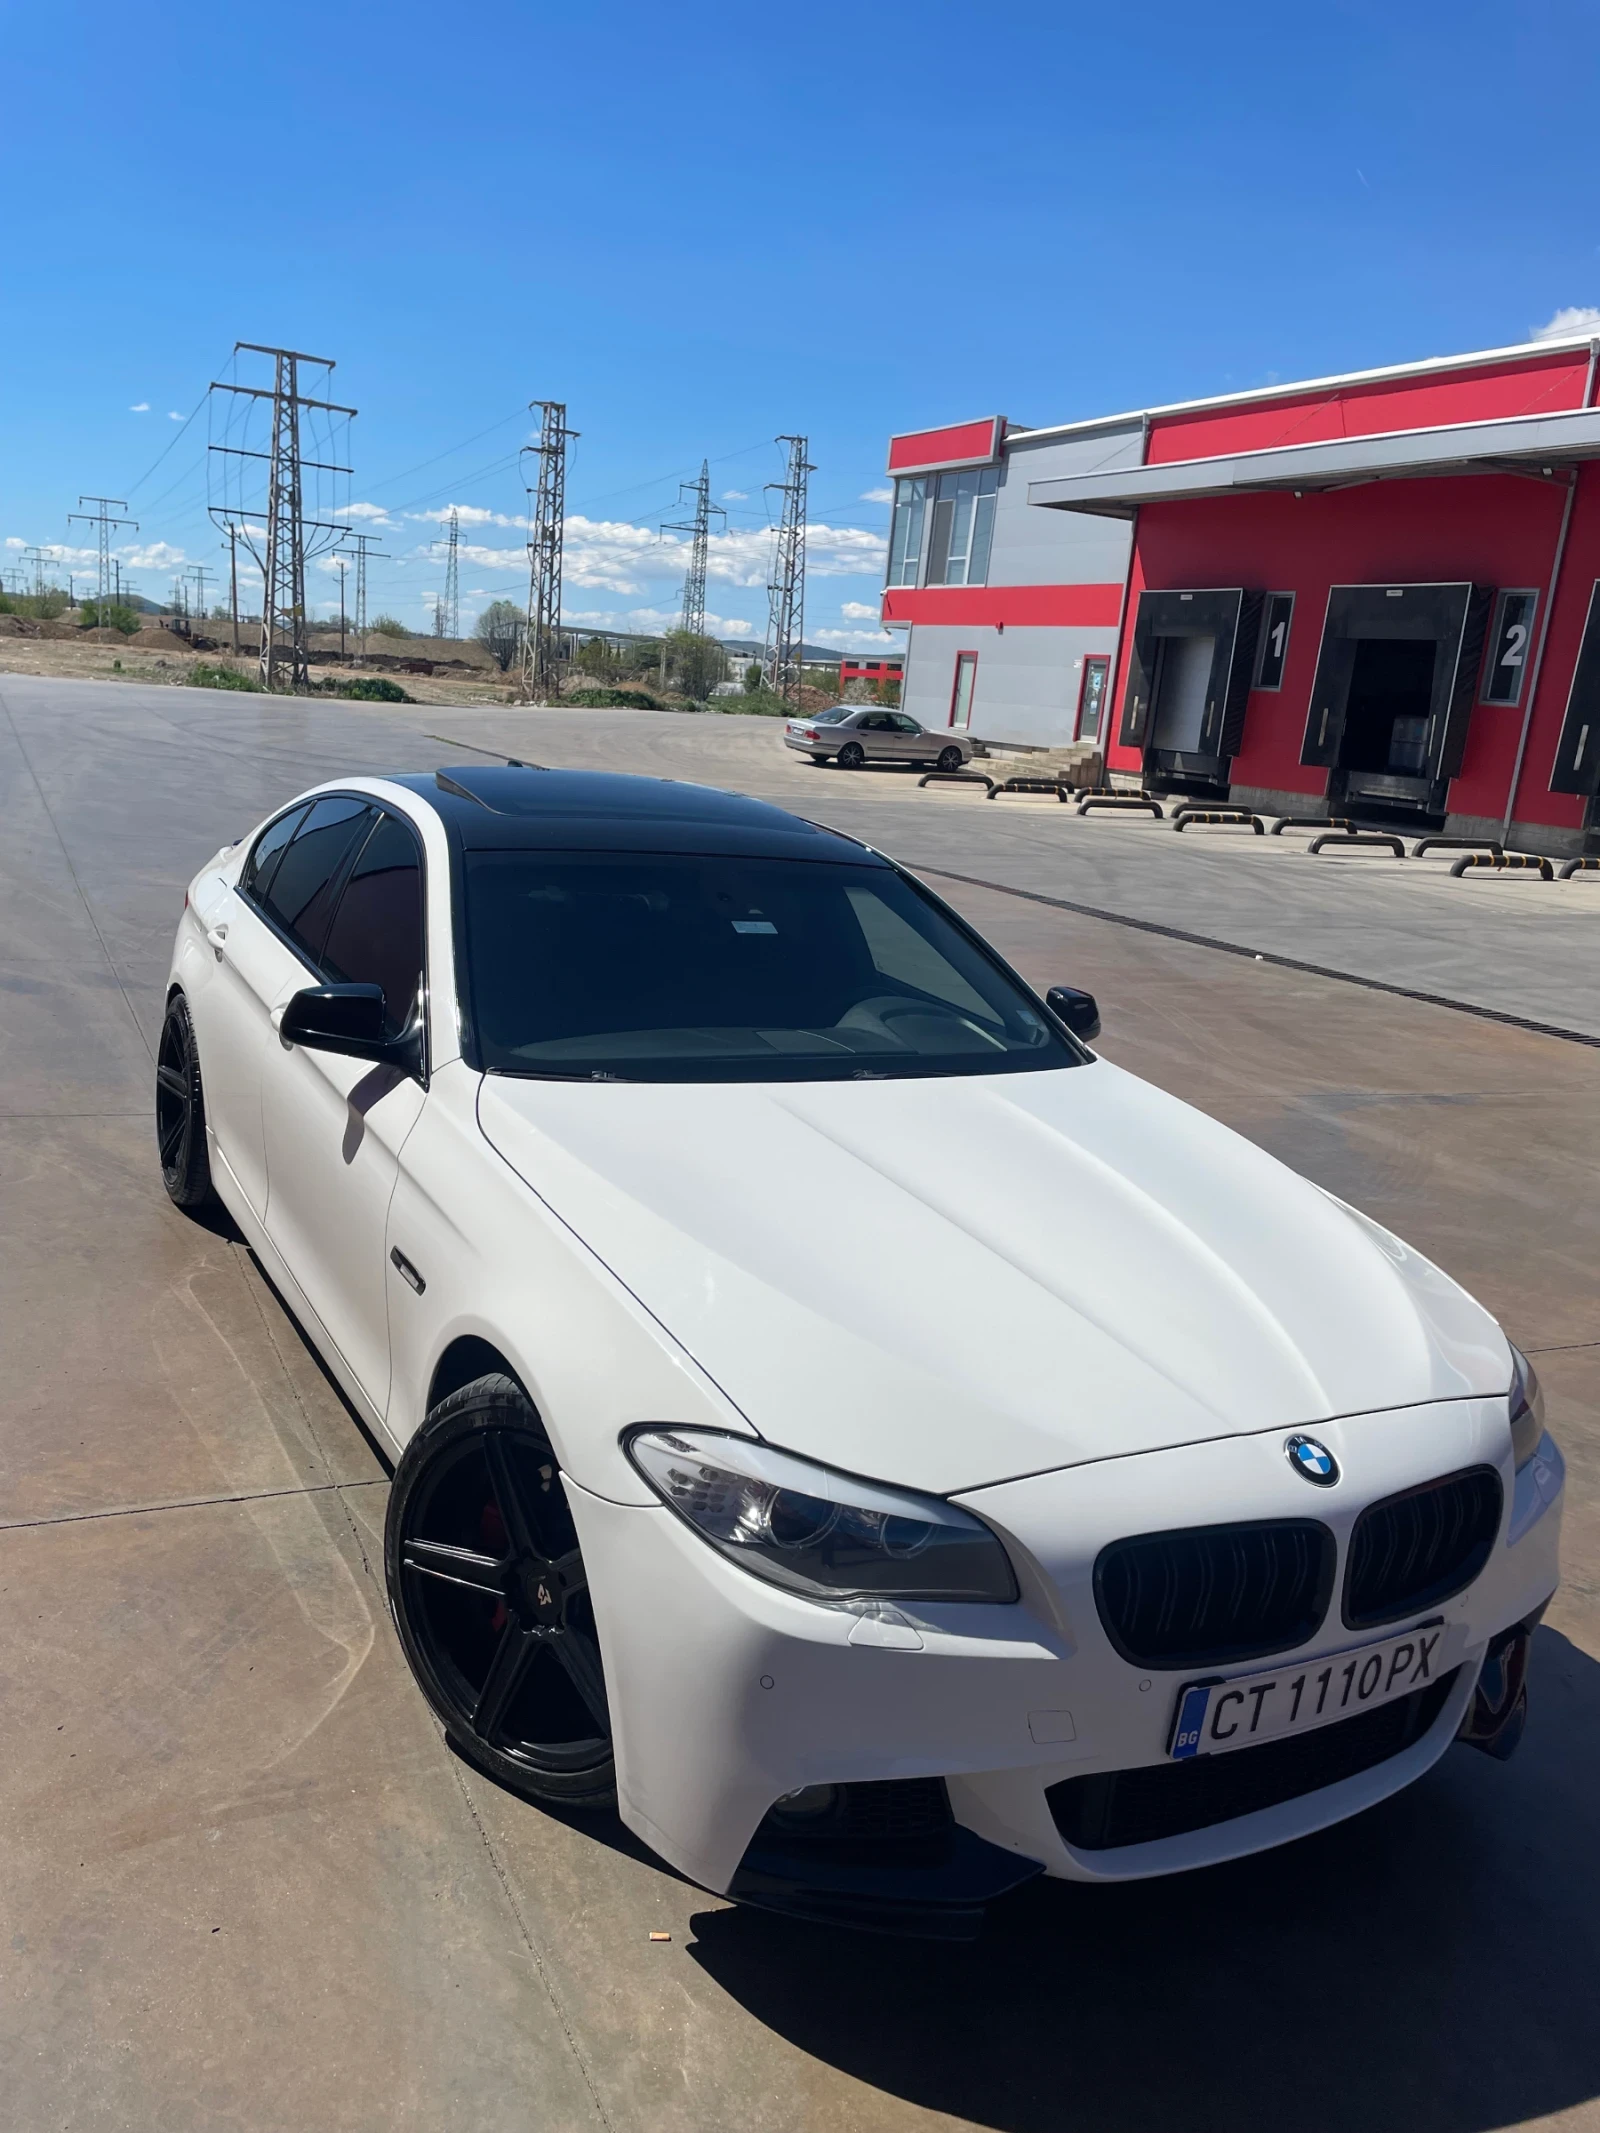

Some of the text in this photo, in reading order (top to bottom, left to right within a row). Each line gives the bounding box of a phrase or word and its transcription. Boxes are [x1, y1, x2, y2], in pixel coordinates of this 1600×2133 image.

[1272, 622, 1286, 658] 1
[1501, 625, 1527, 666] 2
[1288, 1436, 1324, 1453] BMW
[1211, 1683, 1276, 1740] CT
[1177, 1730, 1198, 1747] BG
